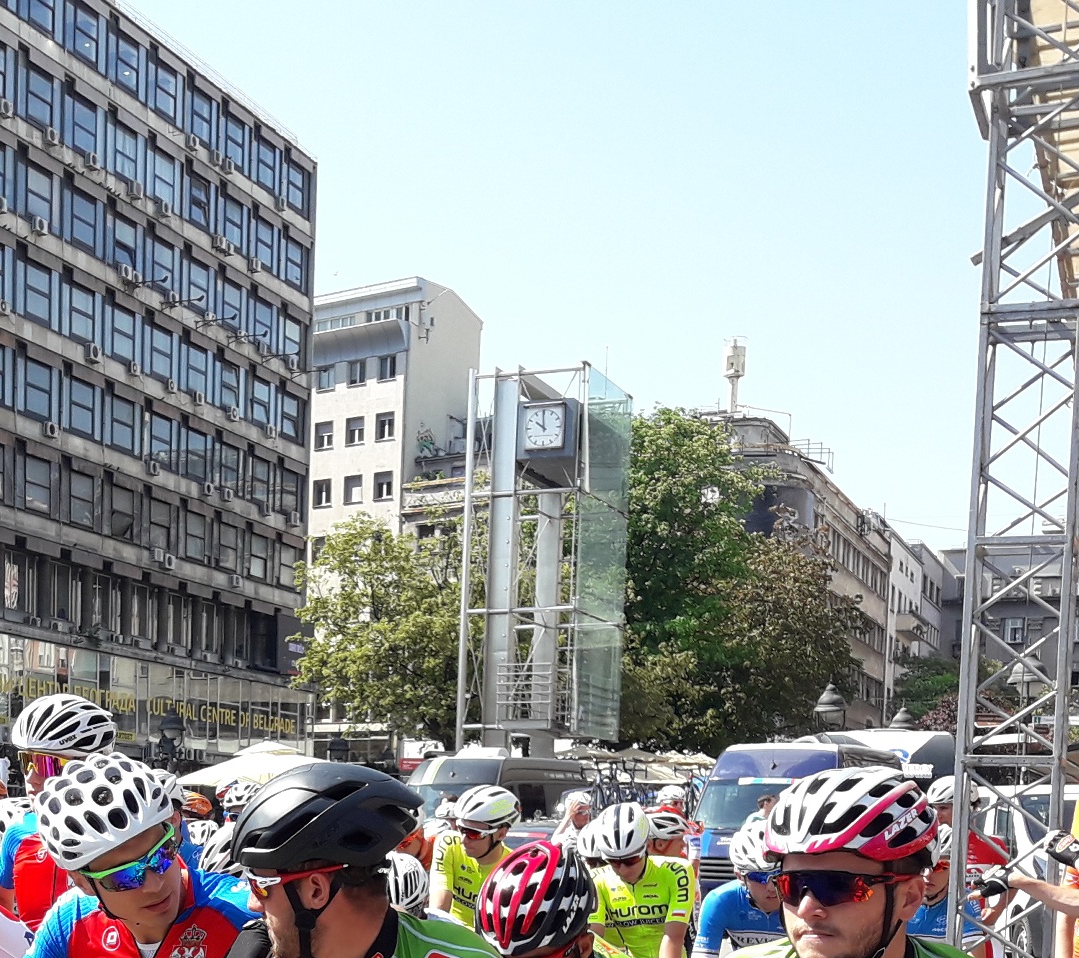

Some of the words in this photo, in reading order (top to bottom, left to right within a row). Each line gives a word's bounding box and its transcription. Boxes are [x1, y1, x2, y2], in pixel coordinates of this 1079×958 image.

[200, 705, 237, 726] CENTRE
[253, 714, 295, 734] BELGRADE
[884, 809, 918, 841] LAZER
